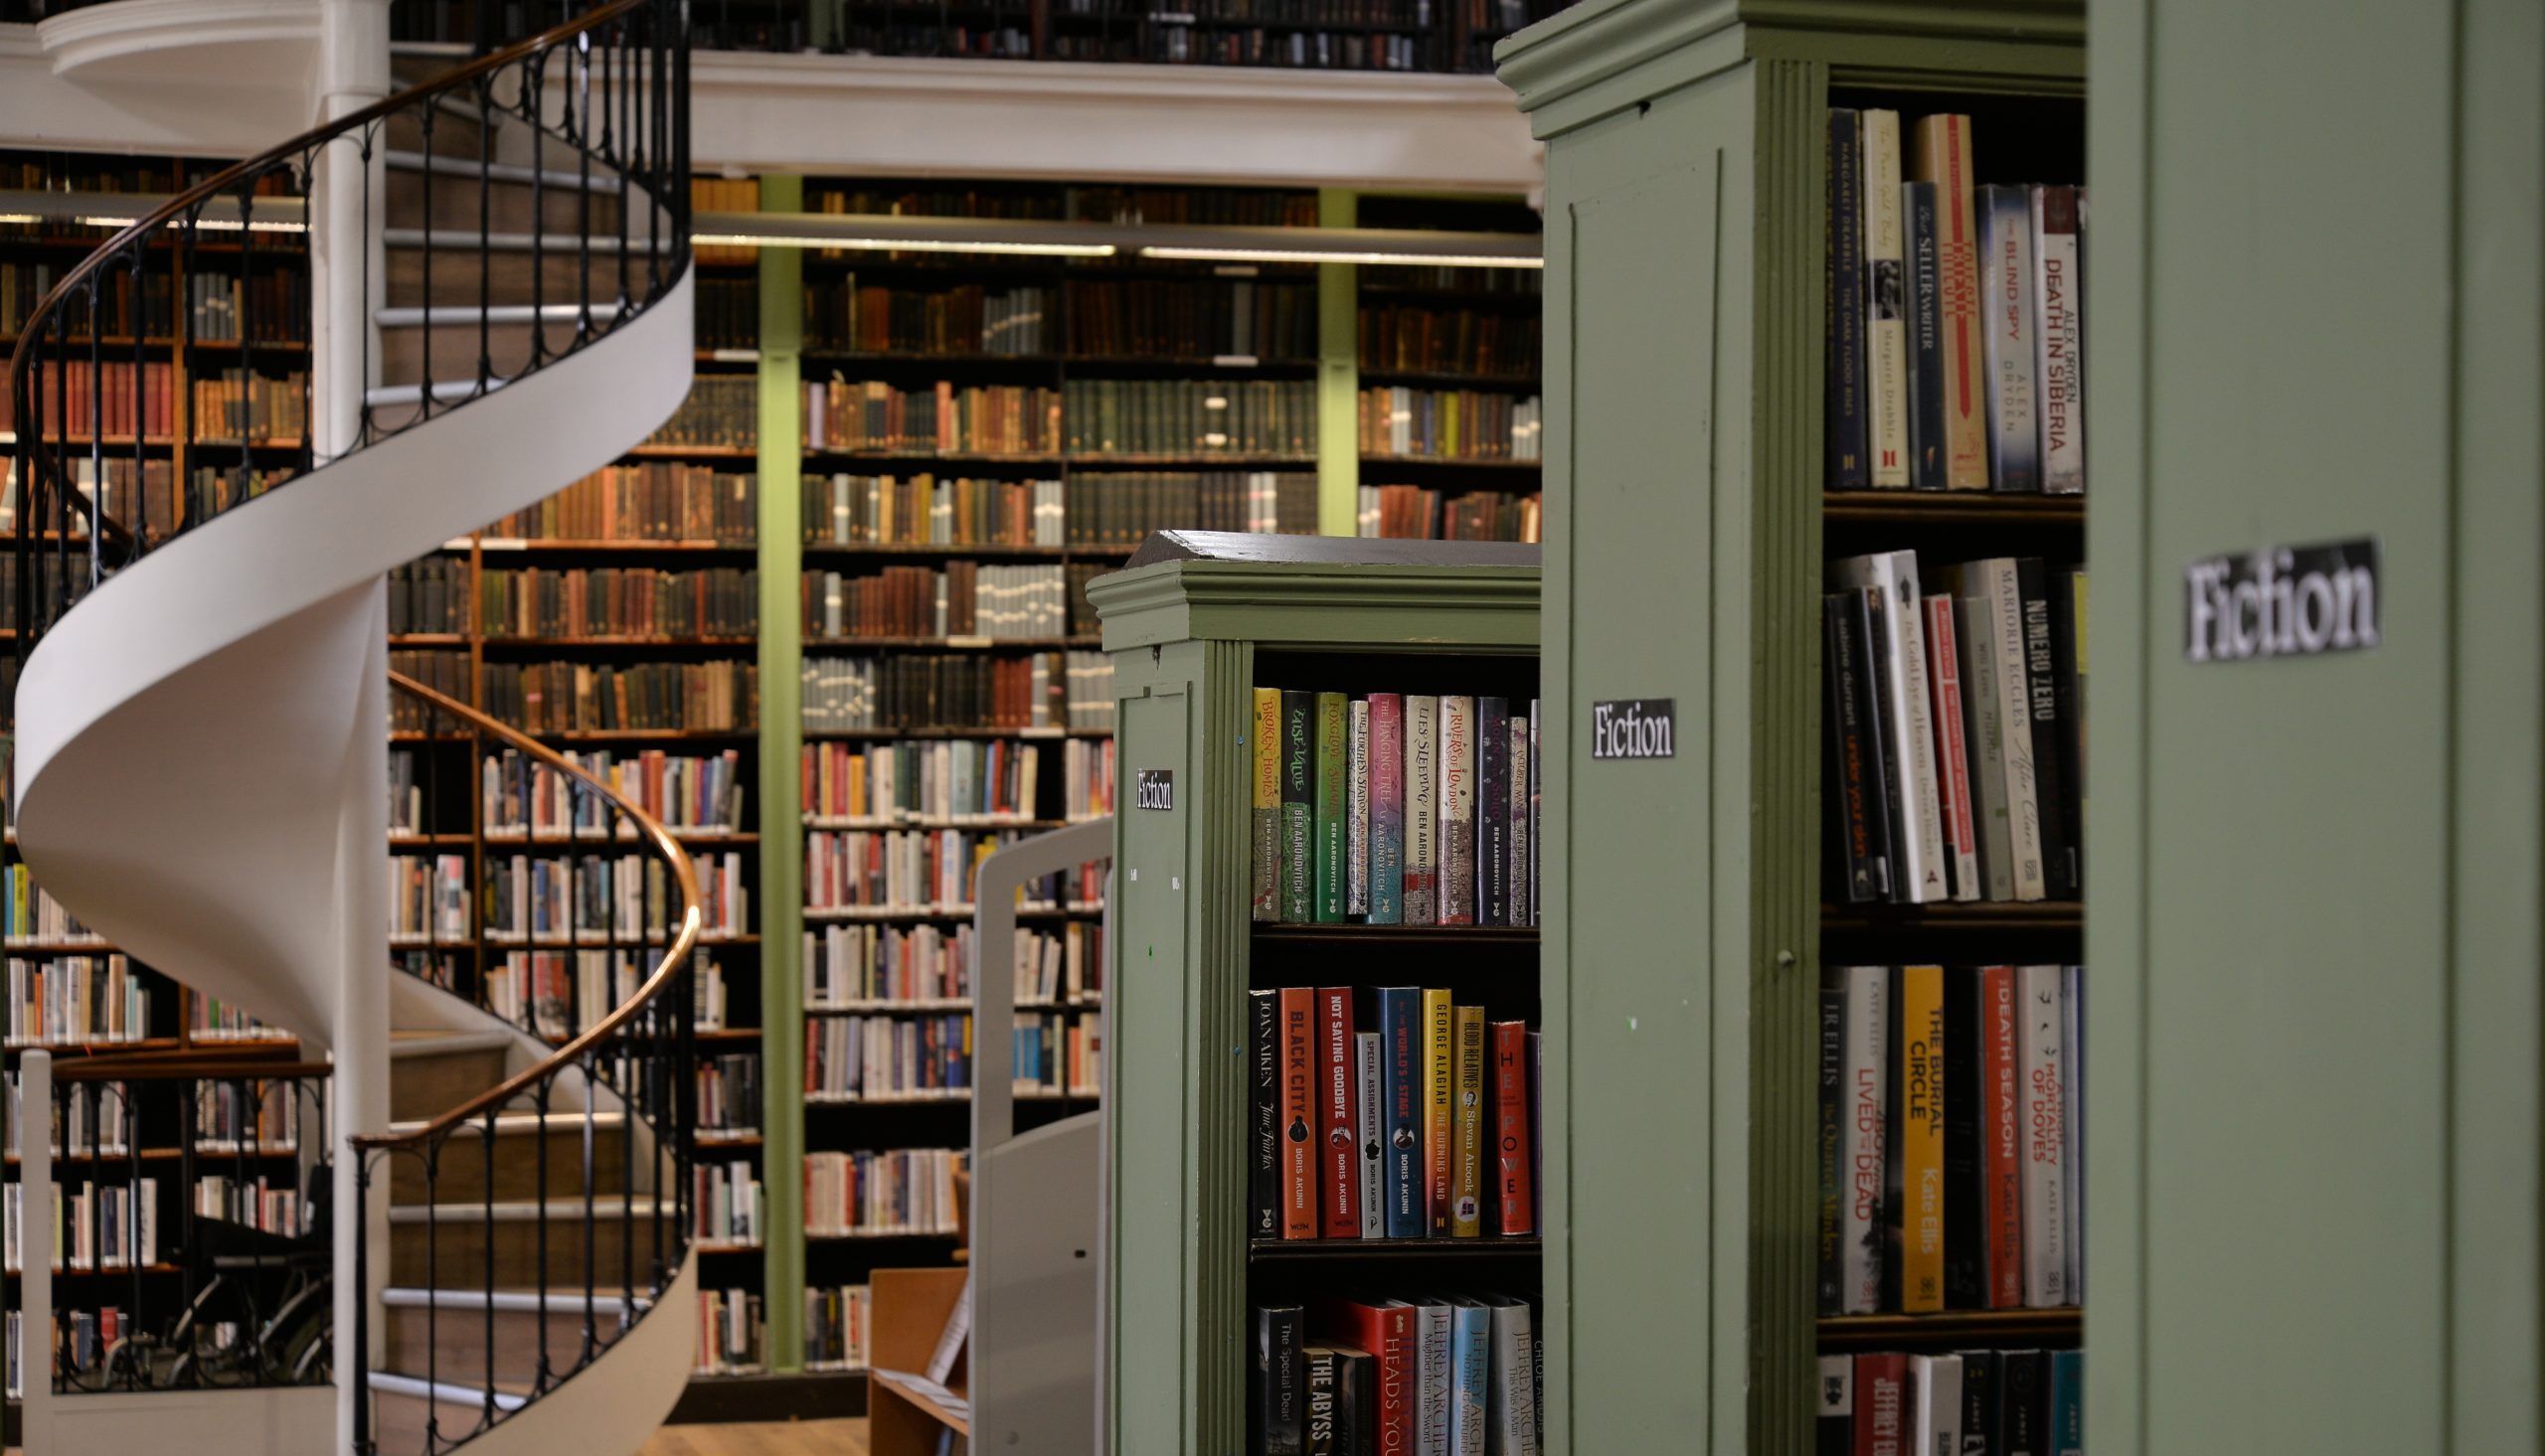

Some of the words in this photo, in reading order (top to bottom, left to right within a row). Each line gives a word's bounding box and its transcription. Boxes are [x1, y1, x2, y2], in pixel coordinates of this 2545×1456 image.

[1842, 216, 1852, 272] DRABBLE
[2004, 241, 2018, 299] BLIND
[2044, 258, 2064, 329] DEATH
[2006, 304, 2019, 341] SPY
[2064, 310, 2075, 344] ALEX
[2048, 336, 2063, 358] IN
[2002, 360, 2015, 432] DRYDEN
[2016, 374, 2028, 418] ALEX
[2065, 351, 2078, 404] DRYDEN
[2048, 365, 2067, 452] SIBERIA
[2001, 568, 2019, 657] MARJORIE
[2188, 544, 2379, 663] Fiction
[2025, 599, 2053, 672] NUMERO
[1381, 699, 1390, 718] THE
[2008, 663, 2026, 728] ECCLES
[2031, 677, 2055, 722] ZERO
[1262, 700, 1274, 752] BROKEN
[1291, 708, 1305, 744] FALSE
[1328, 699, 1340, 759] FOXGLOVE
[1418, 707, 1430, 735] LIES
[1449, 715, 1464, 755] RIVERS
[1594, 702, 1672, 757] Fiction
[1356, 728, 1368, 774] FURTHEST
[1379, 720, 1393, 770] HANGING
[1449, 755, 1458, 767] OF
[1137, 770, 1171, 809] Fiction
[1263, 757, 1273, 798] HOMES
[1290, 748, 1306, 791] VALUE
[1379, 773, 1392, 803] TREE
[1416, 739, 1430, 806] SLEEPING
[1446, 768, 1463, 812] LONDON
[1356, 775, 1368, 815] STATION
[1293, 809, 1303, 828] BEN
[1418, 811, 1428, 830] BEN
[1293, 830, 1303, 892] AARONOVITCH
[1418, 832, 1428, 894] AARONOVITCH
[1260, 1001, 1272, 1039] JOAN
[1331, 995, 1343, 1019] NOT
[1436, 1004, 1447, 1050] GEORGE
[1930, 1007, 1942, 1050] THE
[1998, 987, 2013, 1061] DEATH
[1289, 1011, 1305, 1069] BLACK
[1331, 1021, 1344, 1062] SAYING
[1463, 1022, 1480, 1048] BLOOD
[1261, 1041, 1272, 1087] AIKEN
[1436, 1054, 1447, 1105] ALAGIAH
[1462, 1049, 1480, 1088] RELATIVES
[1910, 1042, 1928, 1120] CIRCLE
[2032, 1069, 2045, 1094] OF
[1258, 1101, 1274, 1126] Jane
[1290, 1073, 1305, 1113] CITY
[1333, 1065, 1346, 1119] GOODBYE
[1367, 1078, 1376, 1137] ASSIGNMENTS
[1399, 1084, 1409, 1118] STAGE
[1857, 1068, 1874, 1132] LIVED
[1930, 1056, 1942, 1136] BURIAL
[2000, 1067, 2015, 1158] SEASON
[1437, 1111, 1446, 1128] THE
[1466, 1110, 1475, 1150] Stevan
[2032, 1100, 2046, 1162] DOVES
[2044, 1062, 2057, 1166] MORTALITY
[1437, 1131, 1446, 1173] BURNING
[1464, 1153, 1475, 1193] Alcock
[1295, 1177, 1304, 1210] AKUNIN
[1338, 1183, 1347, 1214] AKUNIN
[1437, 1176, 1445, 1201] LAND
[1855, 1153, 1873, 1220] DEAD
[1921, 1168, 1938, 1212] Kate
[2002, 1174, 2015, 1214] Kate
[1921, 1215, 1938, 1255] Ellis
[1281, 1323, 1291, 1345] The
[1423, 1333, 1434, 1373] Mightier
[1430, 1313, 1449, 1381] JEFFREY
[1279, 1349, 1291, 1388] Special
[1312, 1357, 1332, 1386] THE
[1385, 1338, 1401, 1409] HEADS
[1424, 1375, 1433, 1393] than
[1462, 1353, 1472, 1401] NOTHING
[1470, 1332, 1487, 1400] JEFFREY
[1512, 1332, 1532, 1393] JEFFREY
[1280, 1392, 1292, 1421] Dead
[1311, 1391, 1332, 1441] ABYSS
[1424, 1395, 1433, 1410] the
[1509, 1387, 1518, 1403] Was
[1509, 1403, 1517, 1414] A
[1873, 1376, 1899, 1437] JEFFREY
[1423, 1414, 1433, 1443] Sword
[1460, 1404, 1470, 1454] VENTURED
[1510, 1415, 1520, 1436] Man
